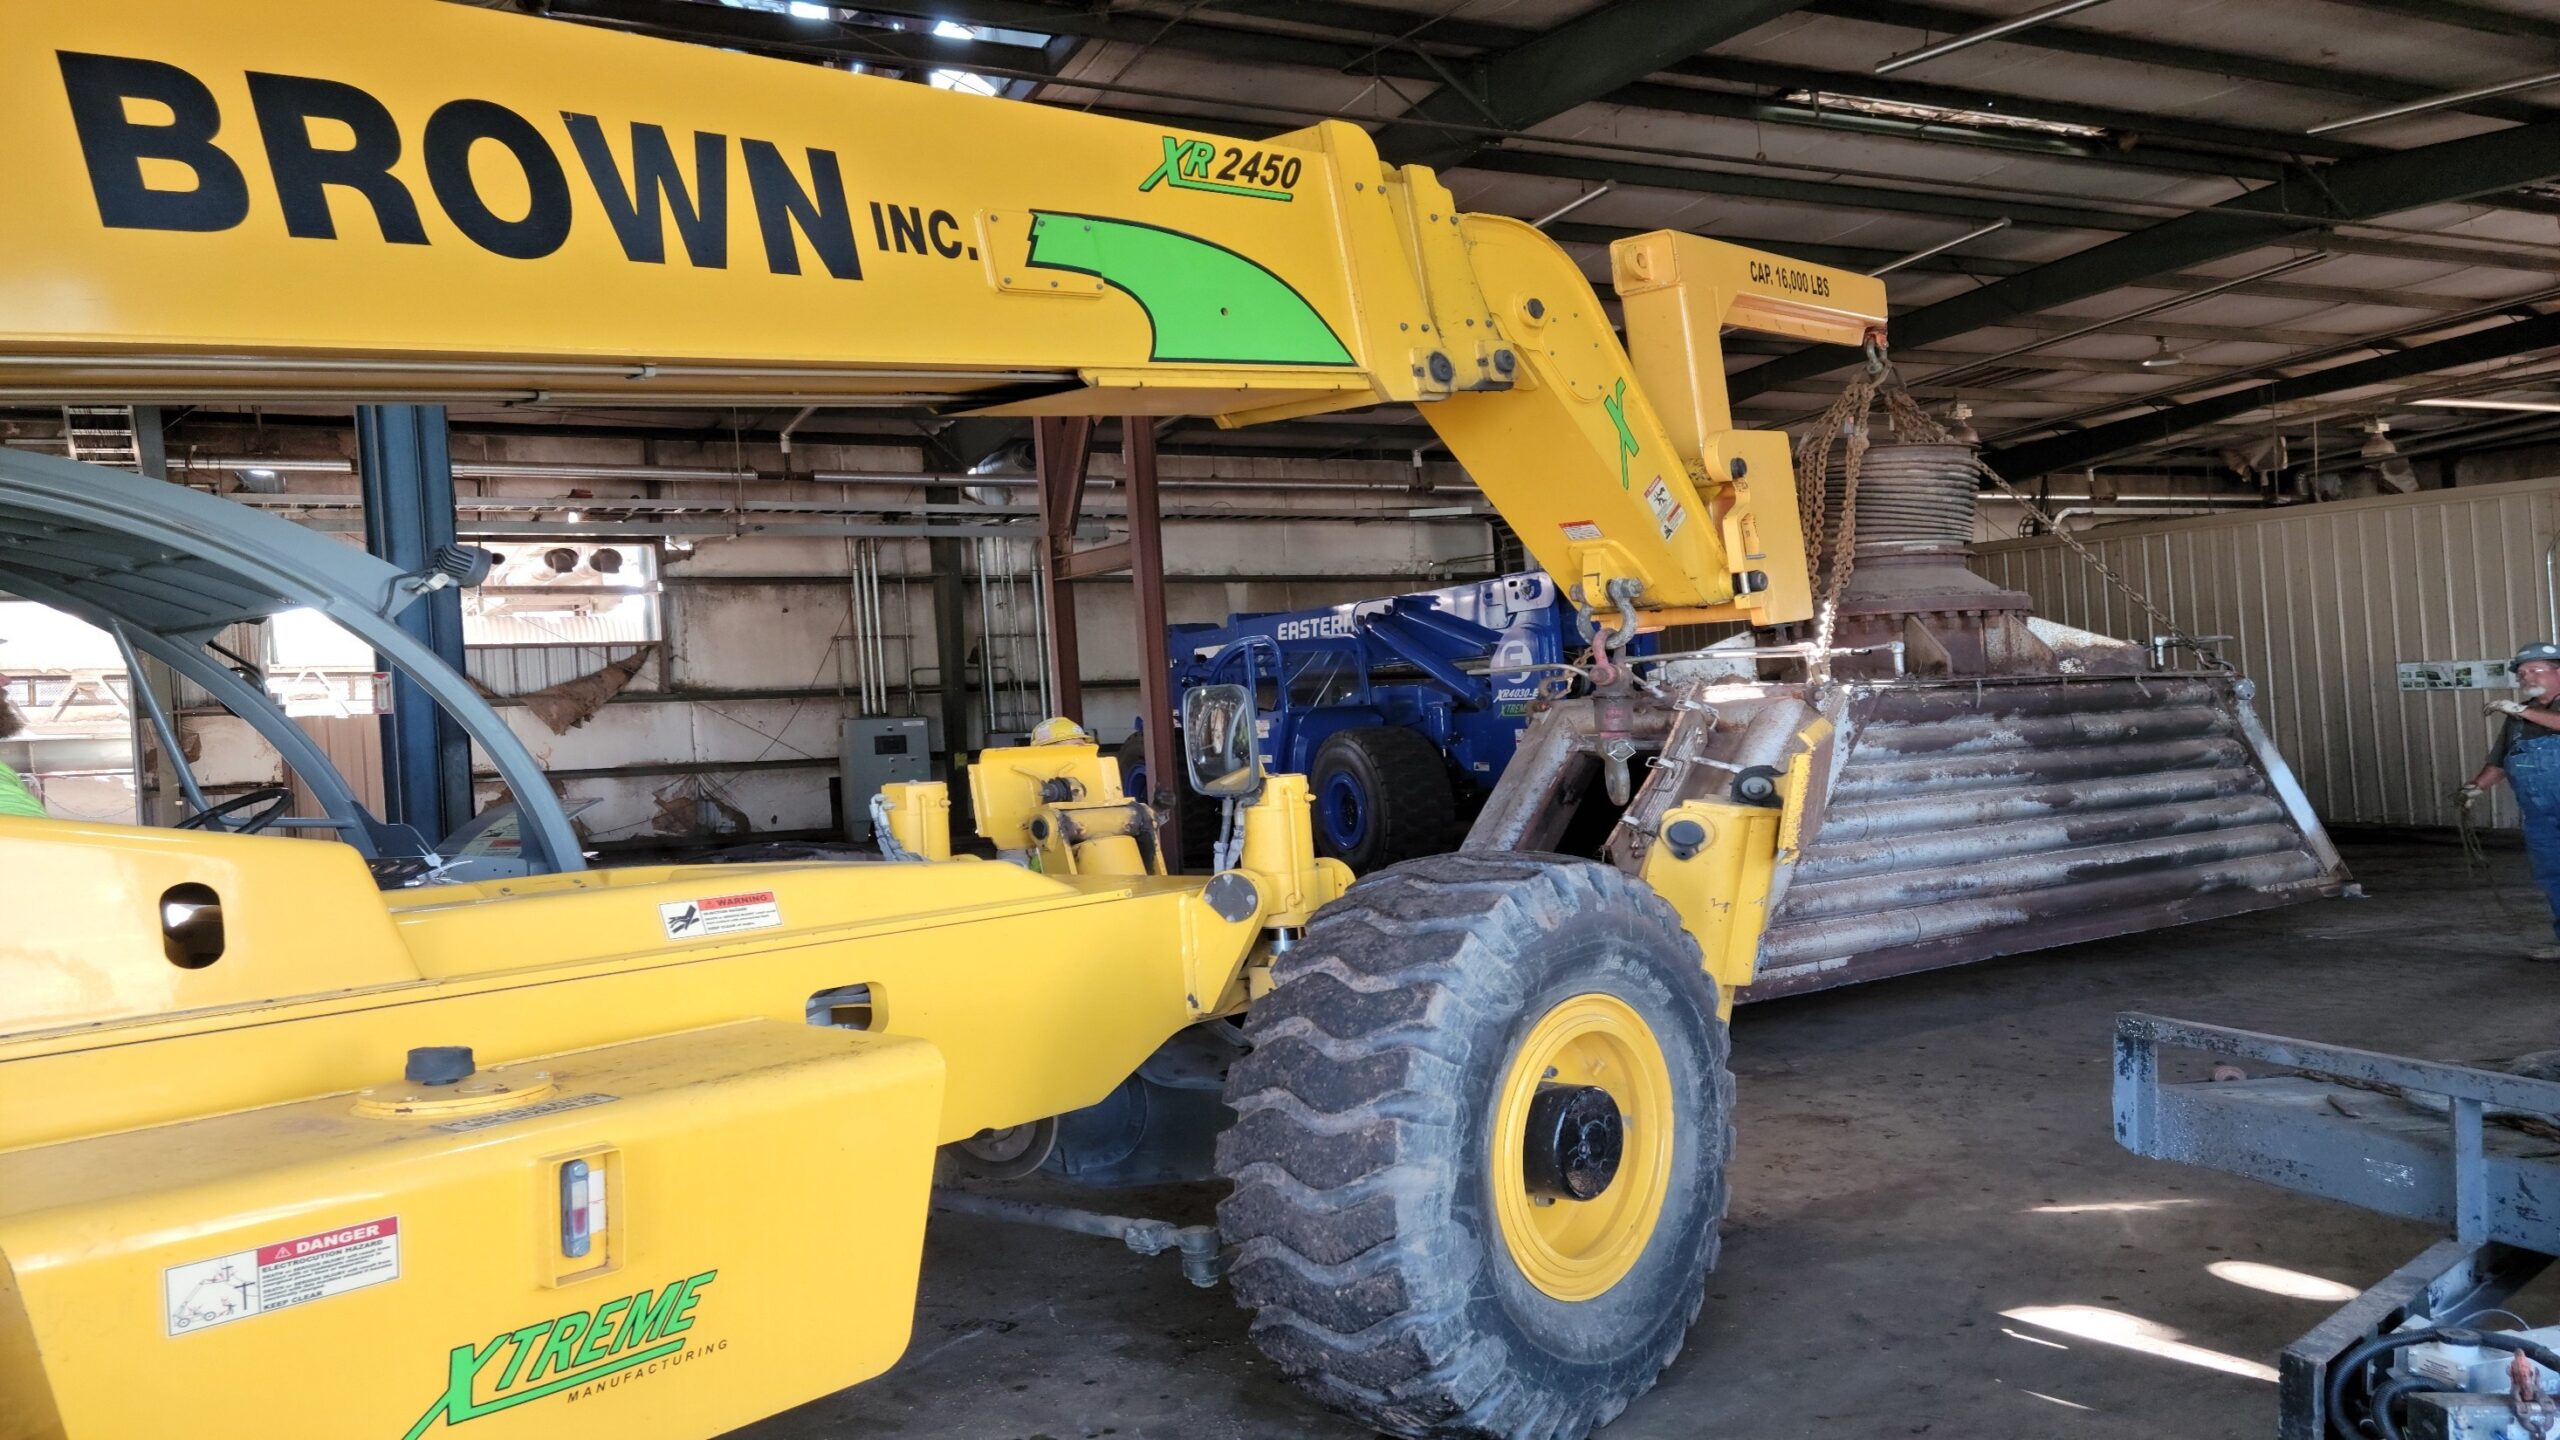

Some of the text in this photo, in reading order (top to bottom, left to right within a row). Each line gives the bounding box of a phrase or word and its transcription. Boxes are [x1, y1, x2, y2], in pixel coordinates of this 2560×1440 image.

[55, 50, 979, 281] BROWN INC.
[1140, 135, 1302, 192] XR 2450
[1750, 261, 1830, 298] CAP. 16,000 LBS
[1498, 702, 1528, 719] XTREM
[717, 895, 768, 906] WARNING
[262, 1239, 384, 1273] ELECTROCUTION HAZARD
[296, 1224, 380, 1254] DANGER
[263, 1290, 323, 1311] KEEP CLEAR
[402, 1269, 718, 1440] XTREME
[567, 1339, 728, 1404] MANUFACTURING
